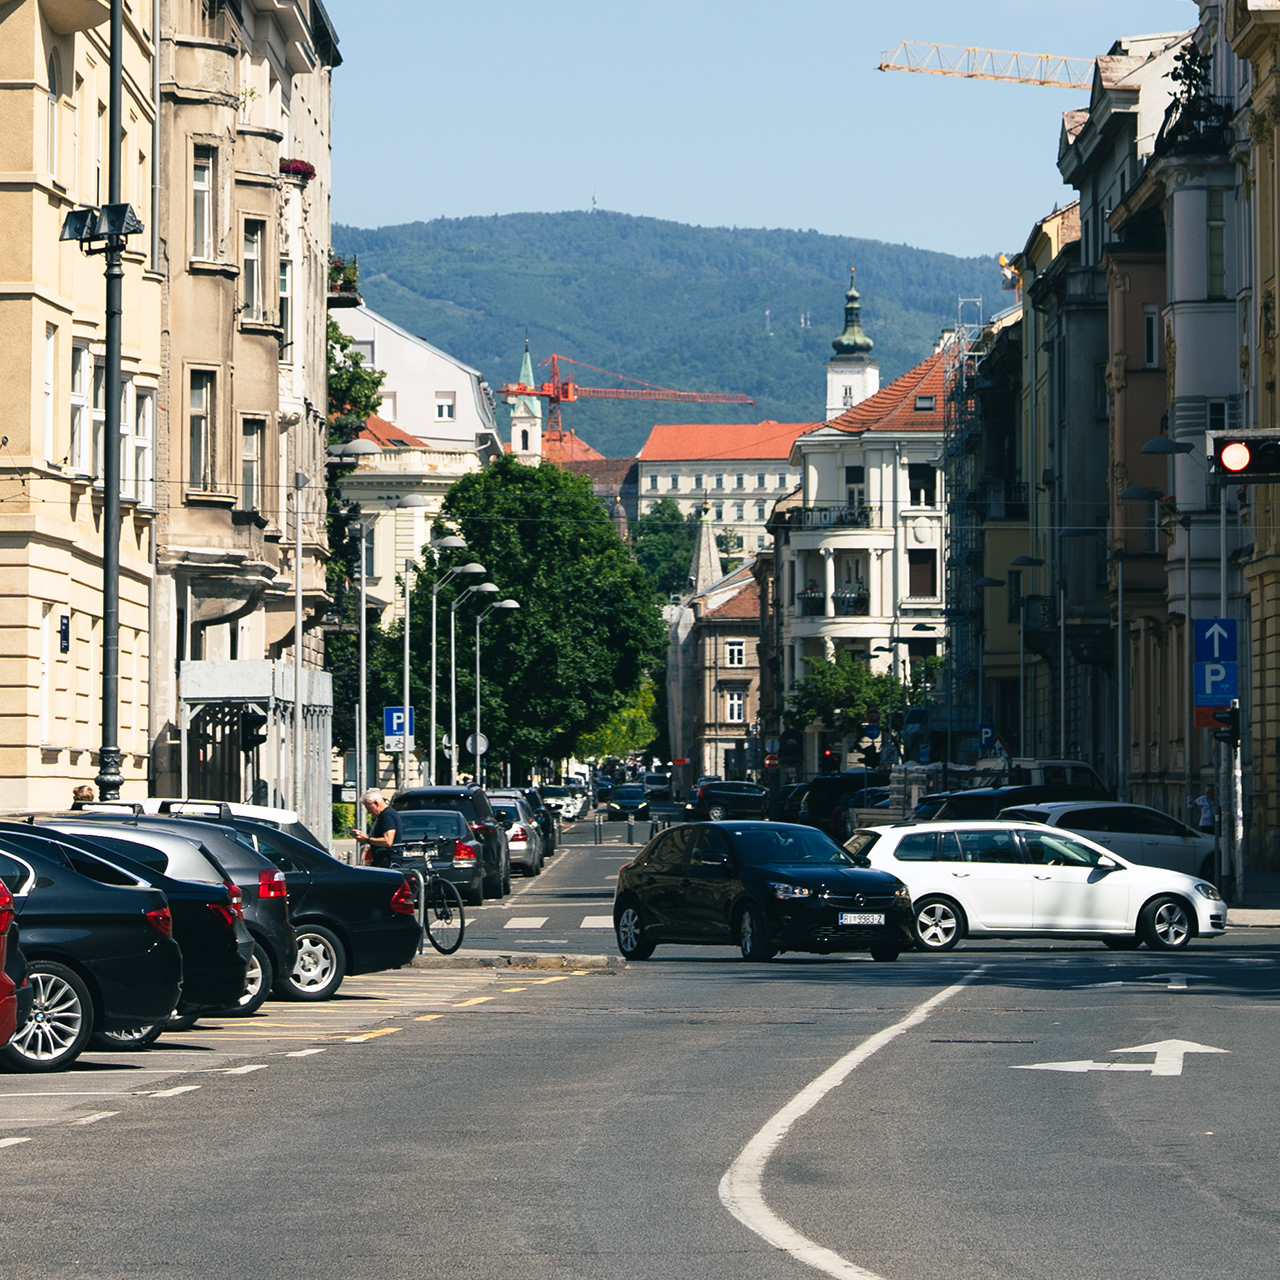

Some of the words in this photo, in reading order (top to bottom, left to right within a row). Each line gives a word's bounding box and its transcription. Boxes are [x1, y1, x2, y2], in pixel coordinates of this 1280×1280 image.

[1205, 663, 1226, 694] P
[392, 712, 405, 731] P
[981, 728, 992, 745] P
